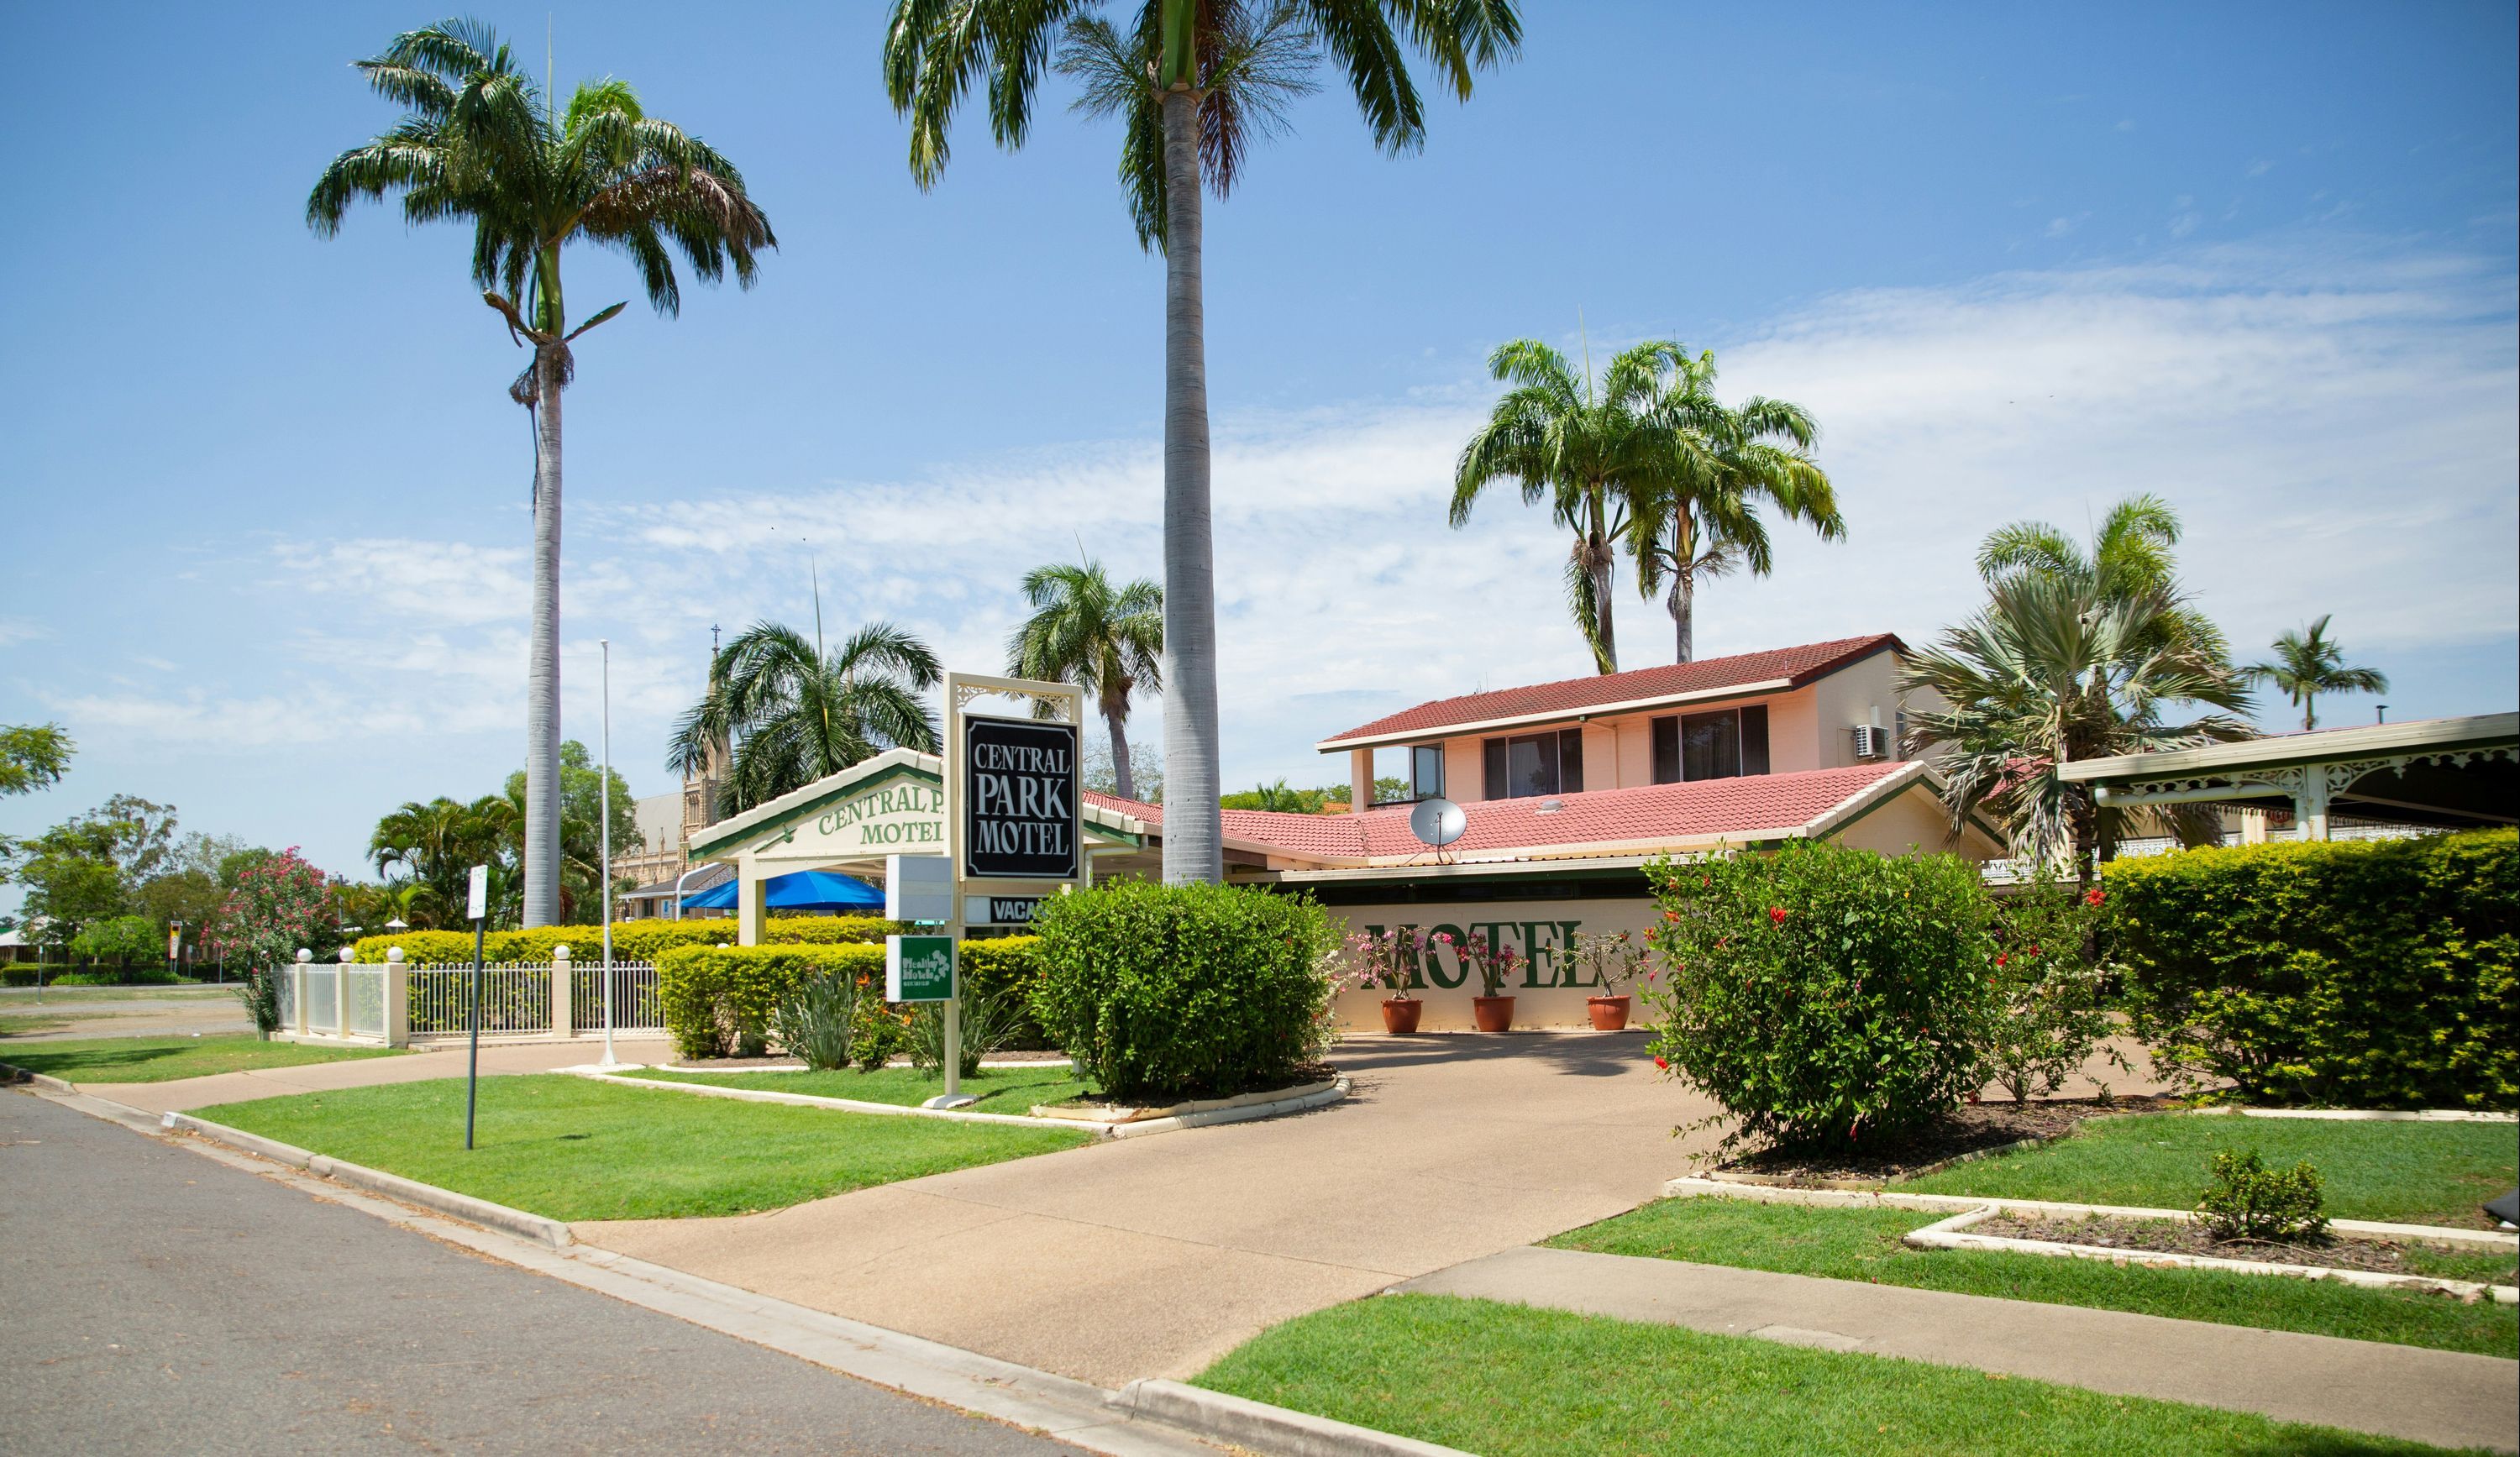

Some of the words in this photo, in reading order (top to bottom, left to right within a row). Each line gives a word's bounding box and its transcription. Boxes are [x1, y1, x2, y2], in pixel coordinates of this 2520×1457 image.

[974, 743, 1071, 774] CENTRAL
[818, 786, 927, 836] CENTRAL
[975, 773, 1071, 820] PARK
[975, 820, 1069, 856] MOTEL
[1360, 920, 1600, 990] MOTEL
